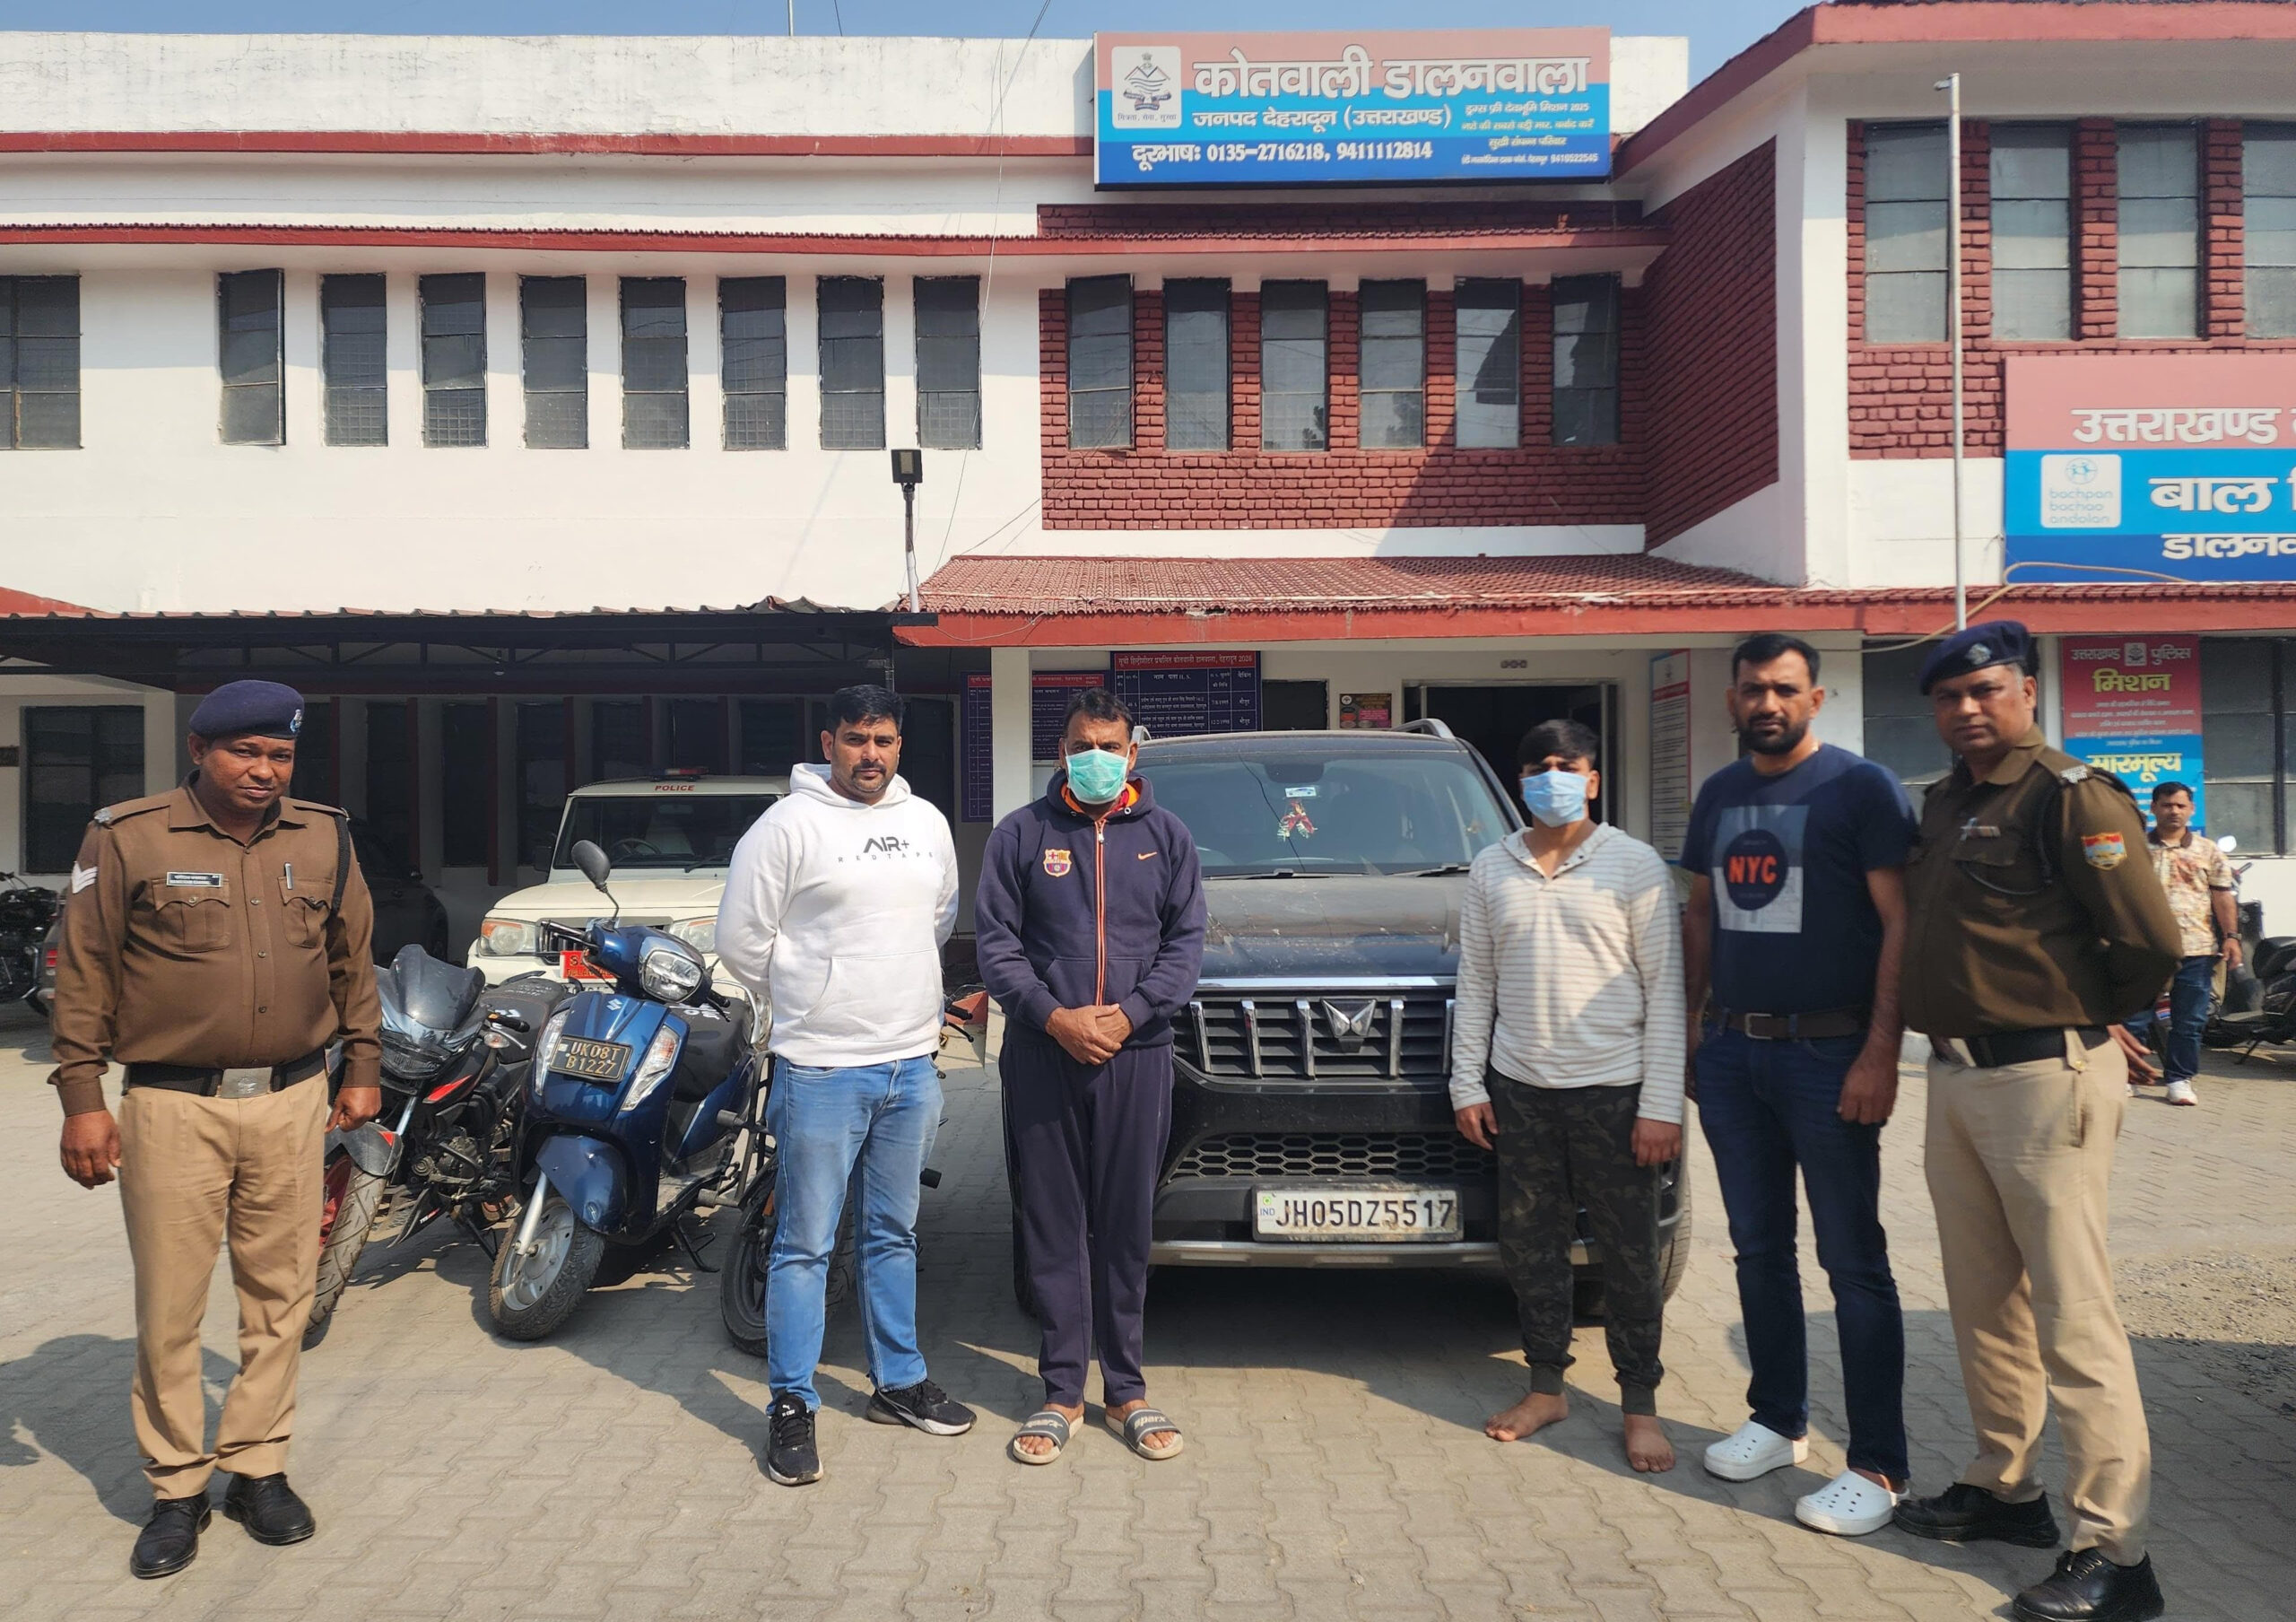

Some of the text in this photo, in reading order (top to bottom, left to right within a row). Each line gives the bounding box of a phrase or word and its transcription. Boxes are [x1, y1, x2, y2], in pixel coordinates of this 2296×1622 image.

[1193, 44, 1592, 99] कोतवाली डालनवाला
[1192, 103, 1453, 134] जनपद देहरादून (उत्तराखण्ड)
[1336, 141, 1433, 161] 9411112814
[2070, 407, 2283, 445] उत्तराखण्ड
[2148, 476, 2279, 514] बाल
[2092, 667, 2172, 693] मिशन
[863, 836, 909, 853] AIR+
[1727, 854, 1778, 885] NYC
[565, 1056, 617, 1076] B1227
[1259, 1208, 1274, 1216] IND
[1275, 1199, 1454, 1227] JH05DZ5517
